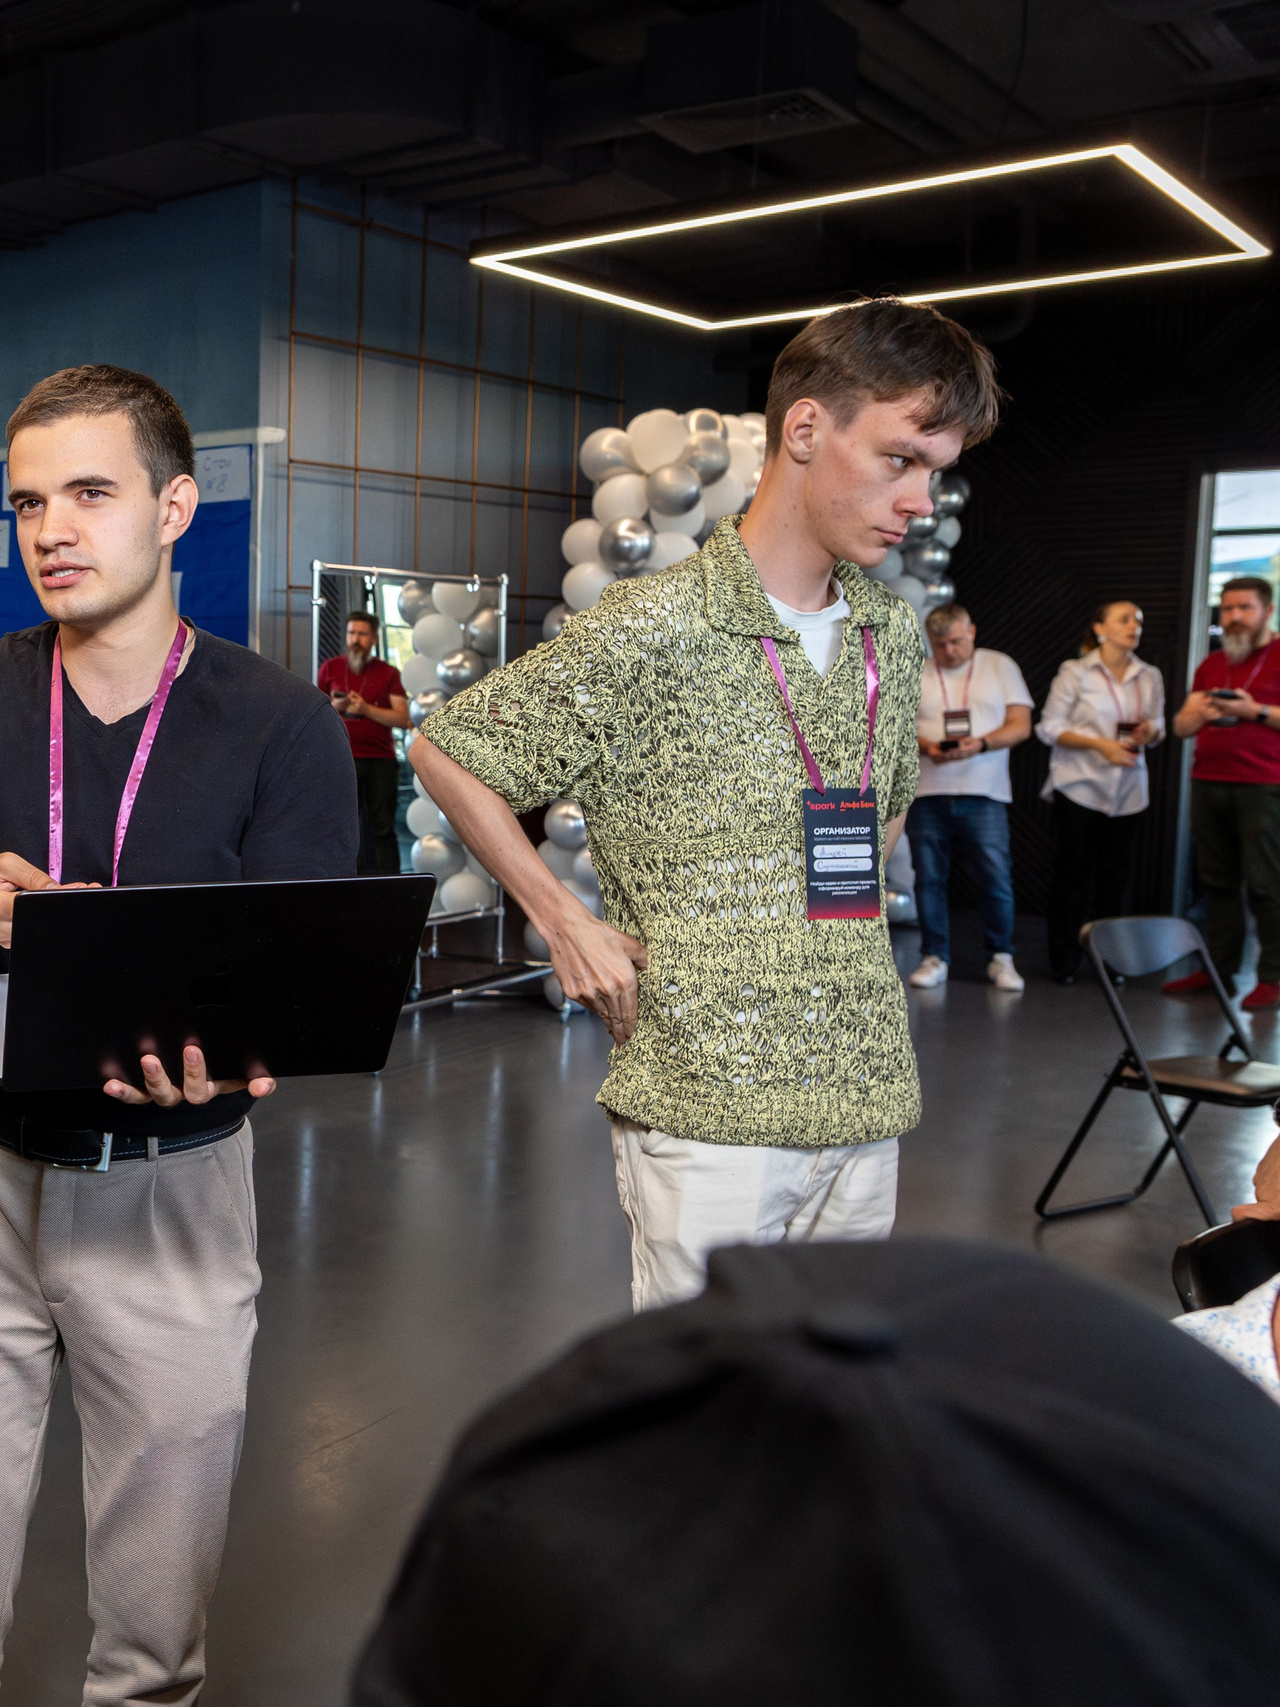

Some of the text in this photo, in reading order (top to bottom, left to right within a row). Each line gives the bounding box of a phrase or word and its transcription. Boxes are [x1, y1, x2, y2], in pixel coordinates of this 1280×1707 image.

[810, 801, 836, 811] spark
[840, 800, 875, 811] Альфа Банк
[814, 826, 871, 835] ОРГАНИЗАТОР
